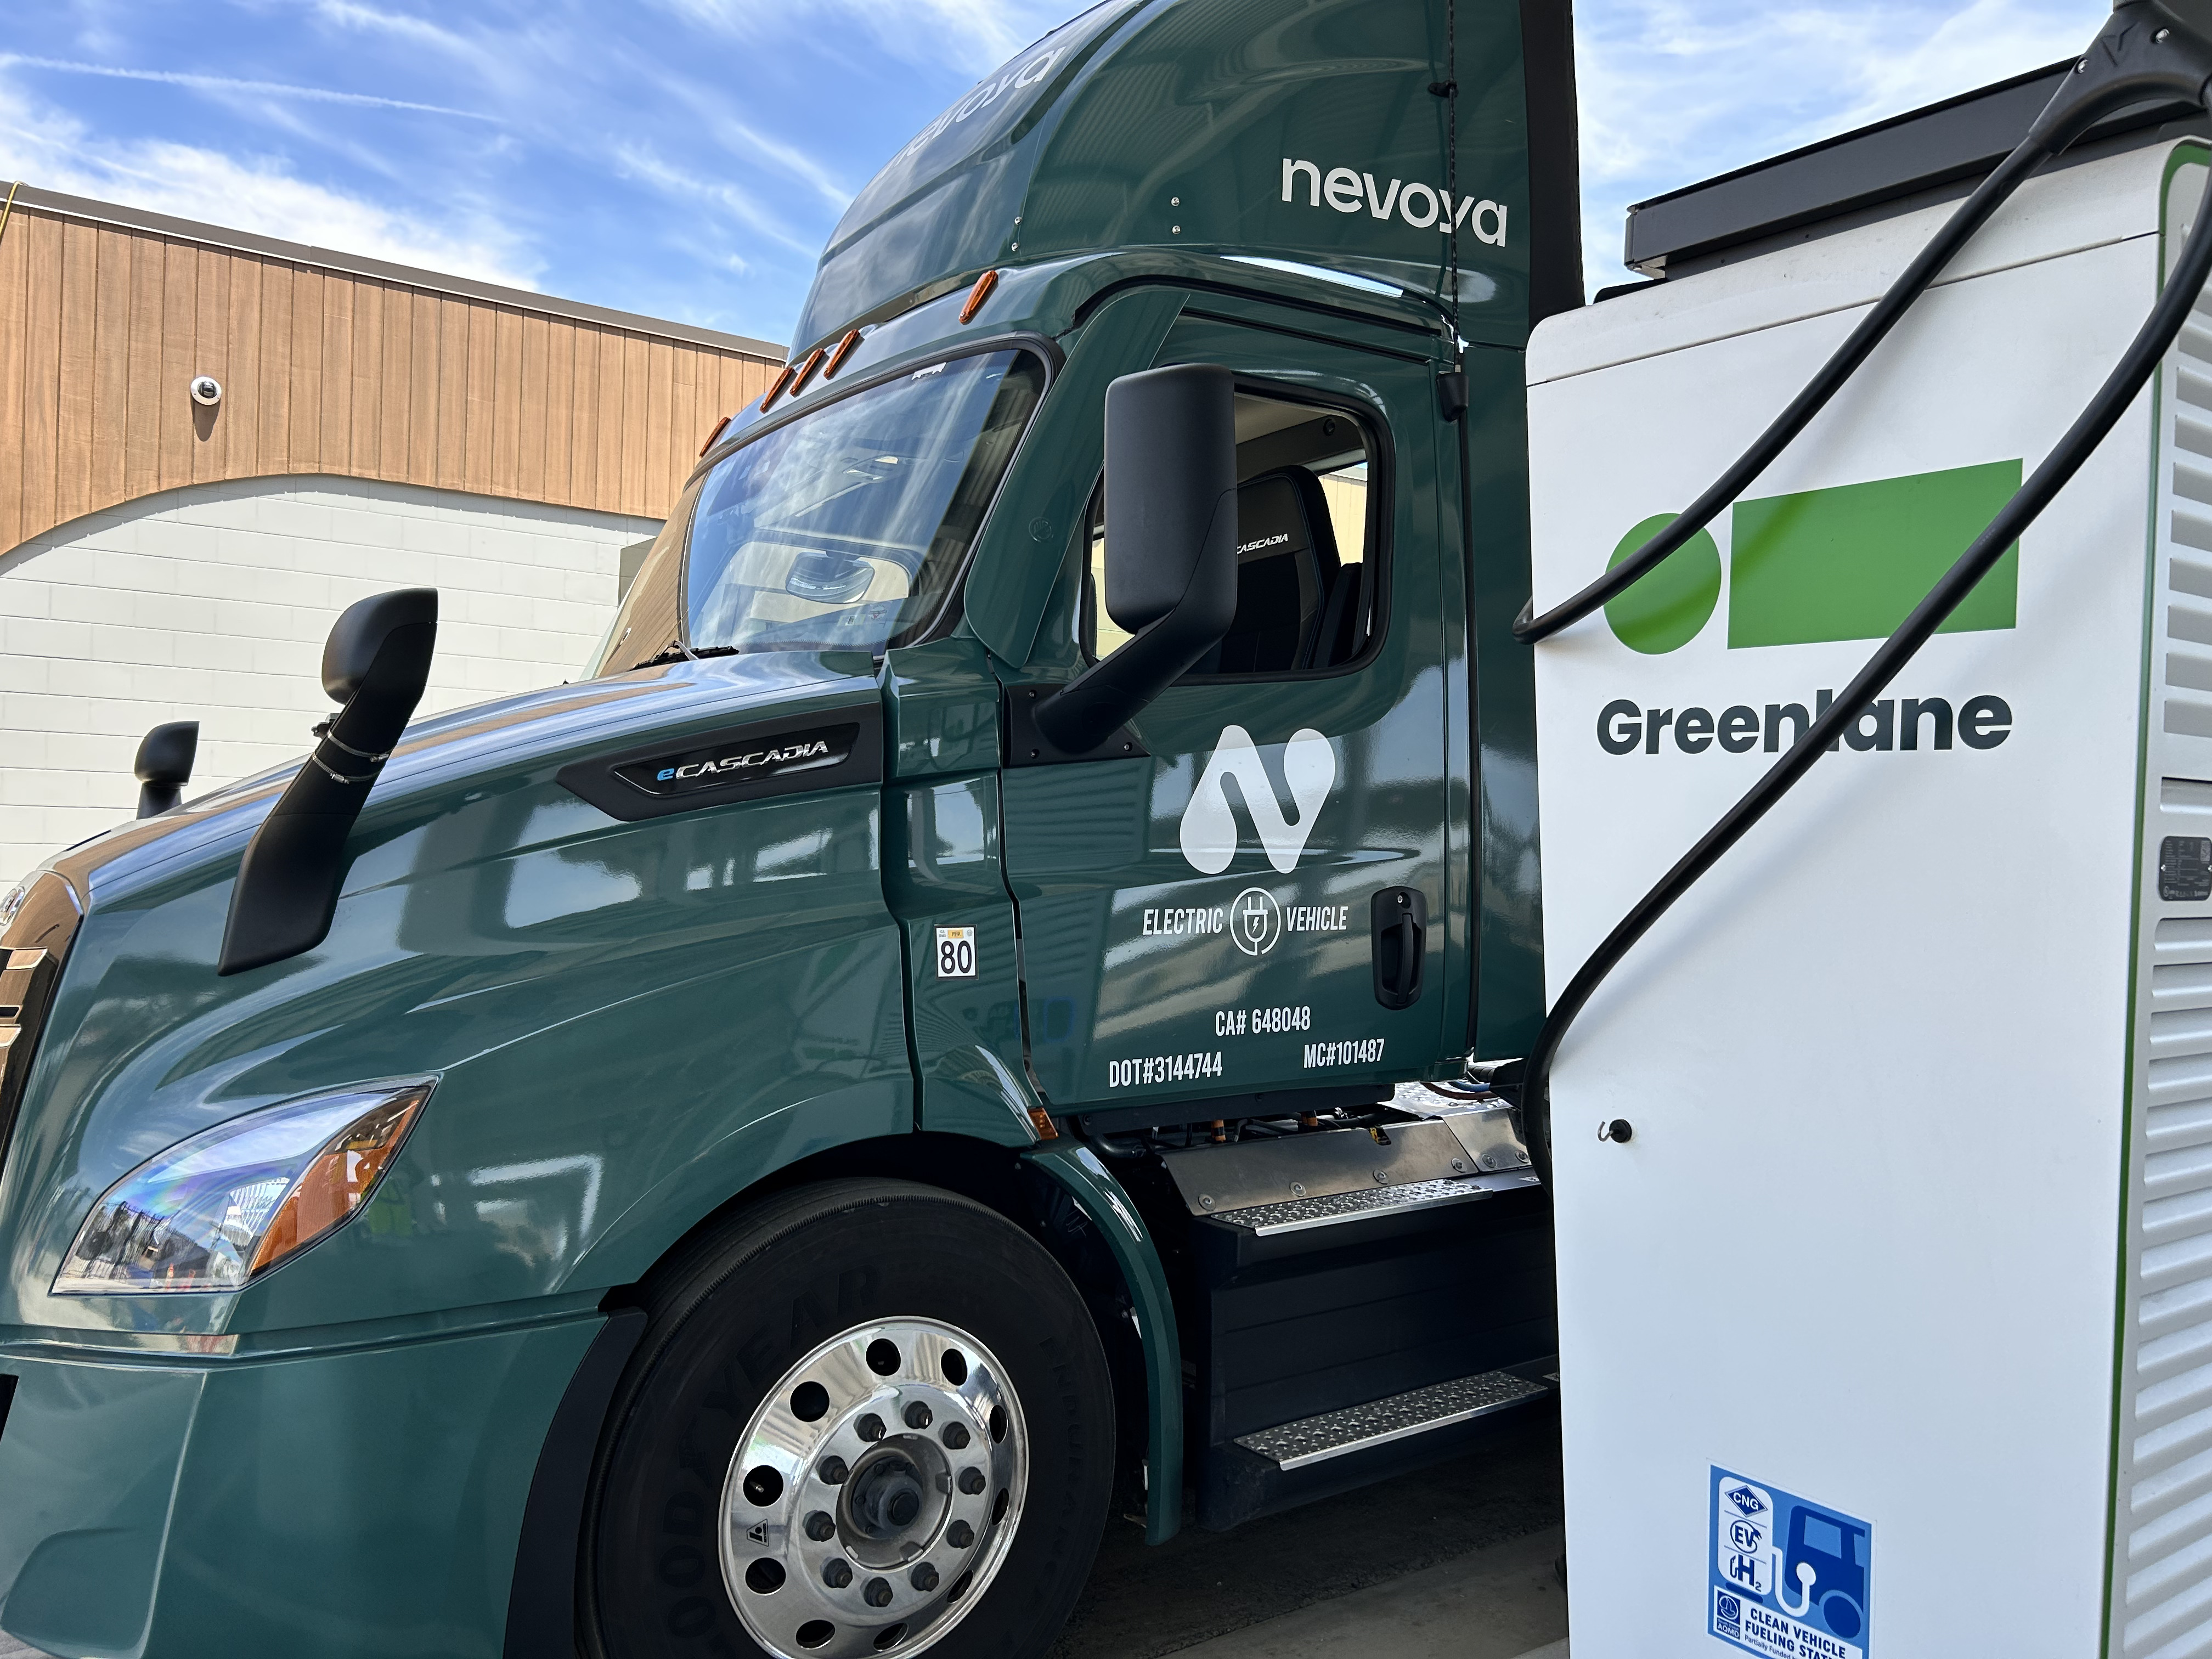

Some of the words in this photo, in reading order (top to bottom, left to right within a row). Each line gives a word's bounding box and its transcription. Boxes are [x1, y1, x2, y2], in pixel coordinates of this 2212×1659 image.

[878, 46, 1066, 179] nevoya
[1282, 158, 1508, 247] nevoya
[657, 741, 829, 781] eCASCADIA
[1143, 908, 1223, 935] ELECTRIC
[1286, 906, 1348, 931] VEHICLE
[941, 940, 972, 974] 80
[1215, 1010, 1247, 1036] CA#
[1252, 1006, 1311, 1034] 648048
[1109, 1051, 1222, 1088] DOT#3144744
[1304, 1038, 1385, 1069] MC#101487
[1733, 1492, 1759, 1511] CNG
[1735, 1524, 1754, 1548] EV
[1718, 1623, 1740, 1638] AQMD
[1745, 1619, 1795, 1652] FUELING
[1745, 1634, 1768, 1651] Partially
[1750, 1607, 1789, 1635] CLEAN
[1793, 1624, 1846, 1659] VEHICLE
